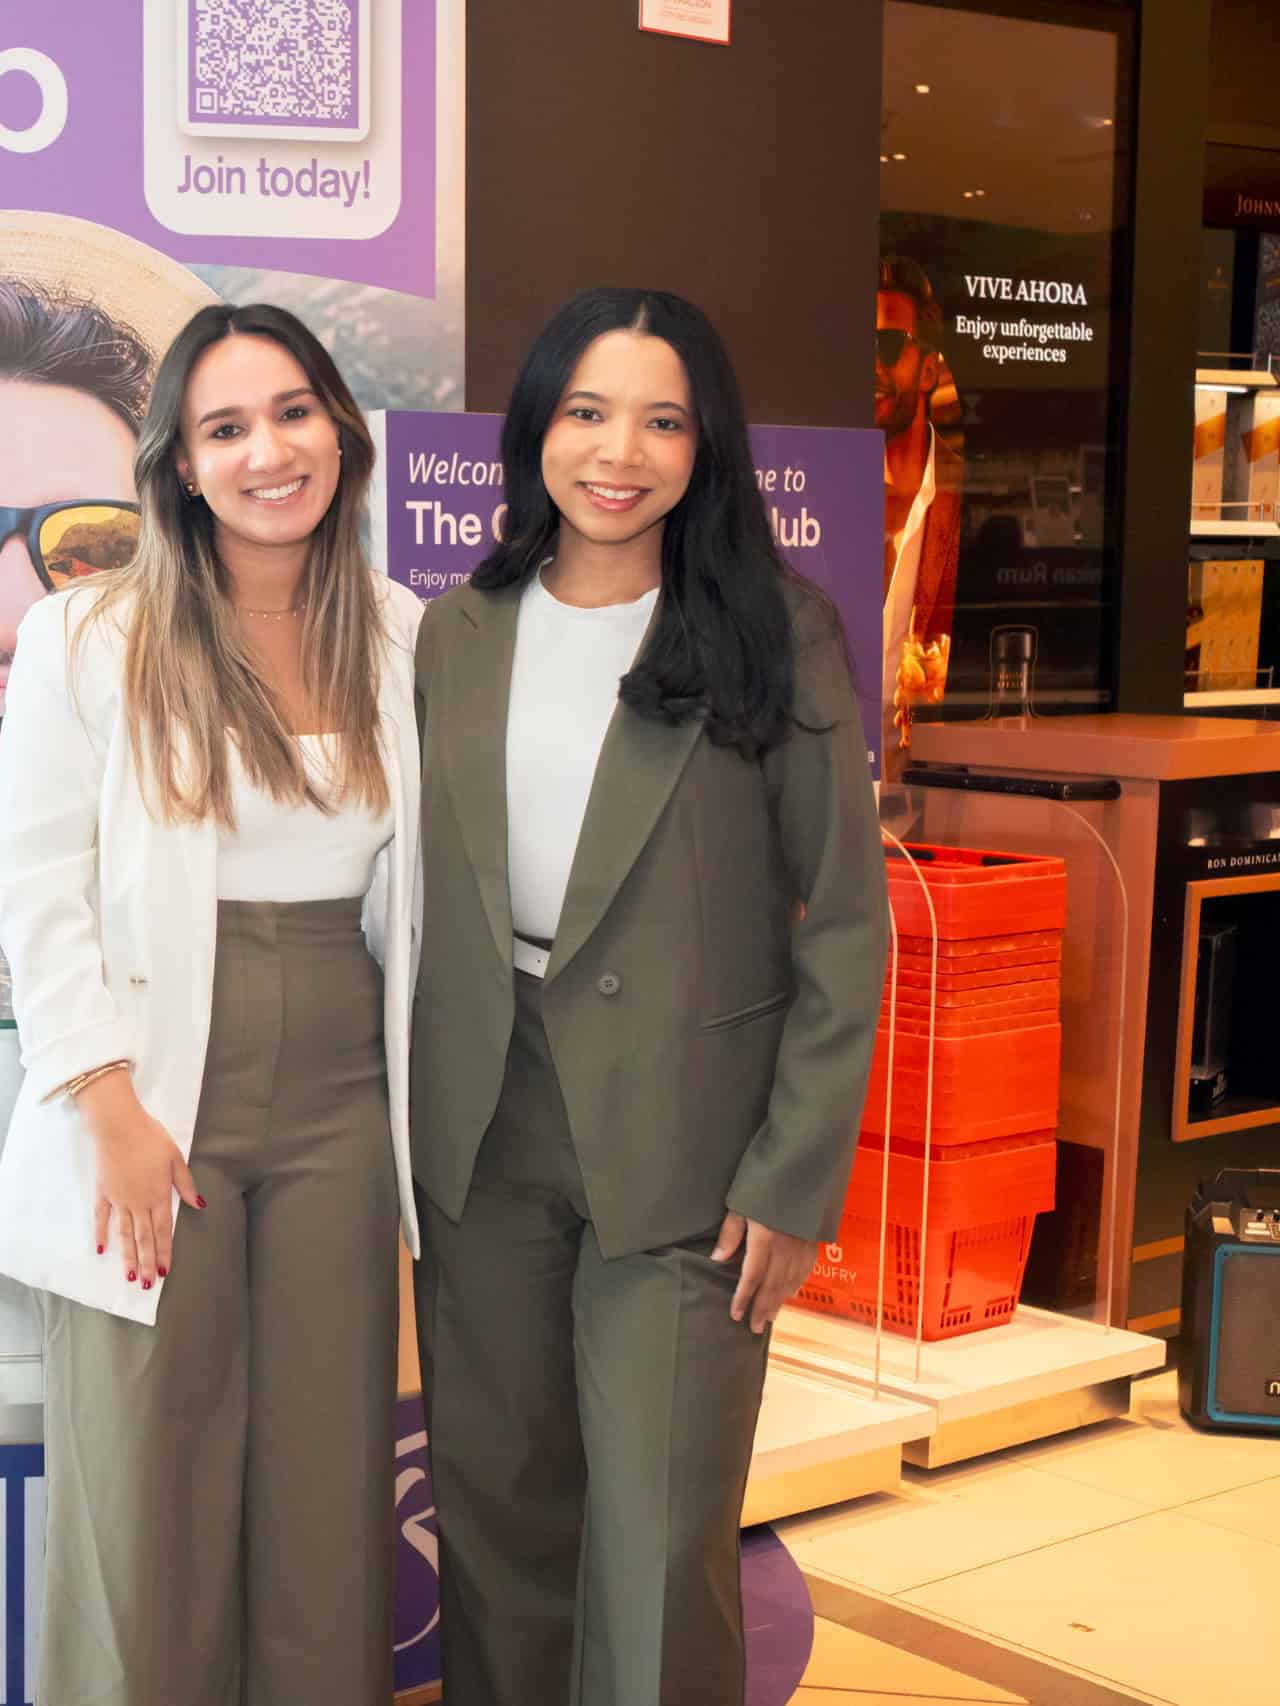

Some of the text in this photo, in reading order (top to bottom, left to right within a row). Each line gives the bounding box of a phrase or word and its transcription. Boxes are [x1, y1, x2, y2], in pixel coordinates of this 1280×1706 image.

[177, 155, 371, 208] Join today!
[964, 275, 1088, 306] VIVE AHORA
[955, 315, 1094, 344] Enjoy unforgettable
[982, 342, 1067, 365] experiences
[783, 465, 806, 492] to
[405, 500, 482, 546] The
[409, 568, 448, 590] Enjoy
[1230, 852, 1280, 867] DOMINICA
[812, 1263, 857, 1285] DUFRY
